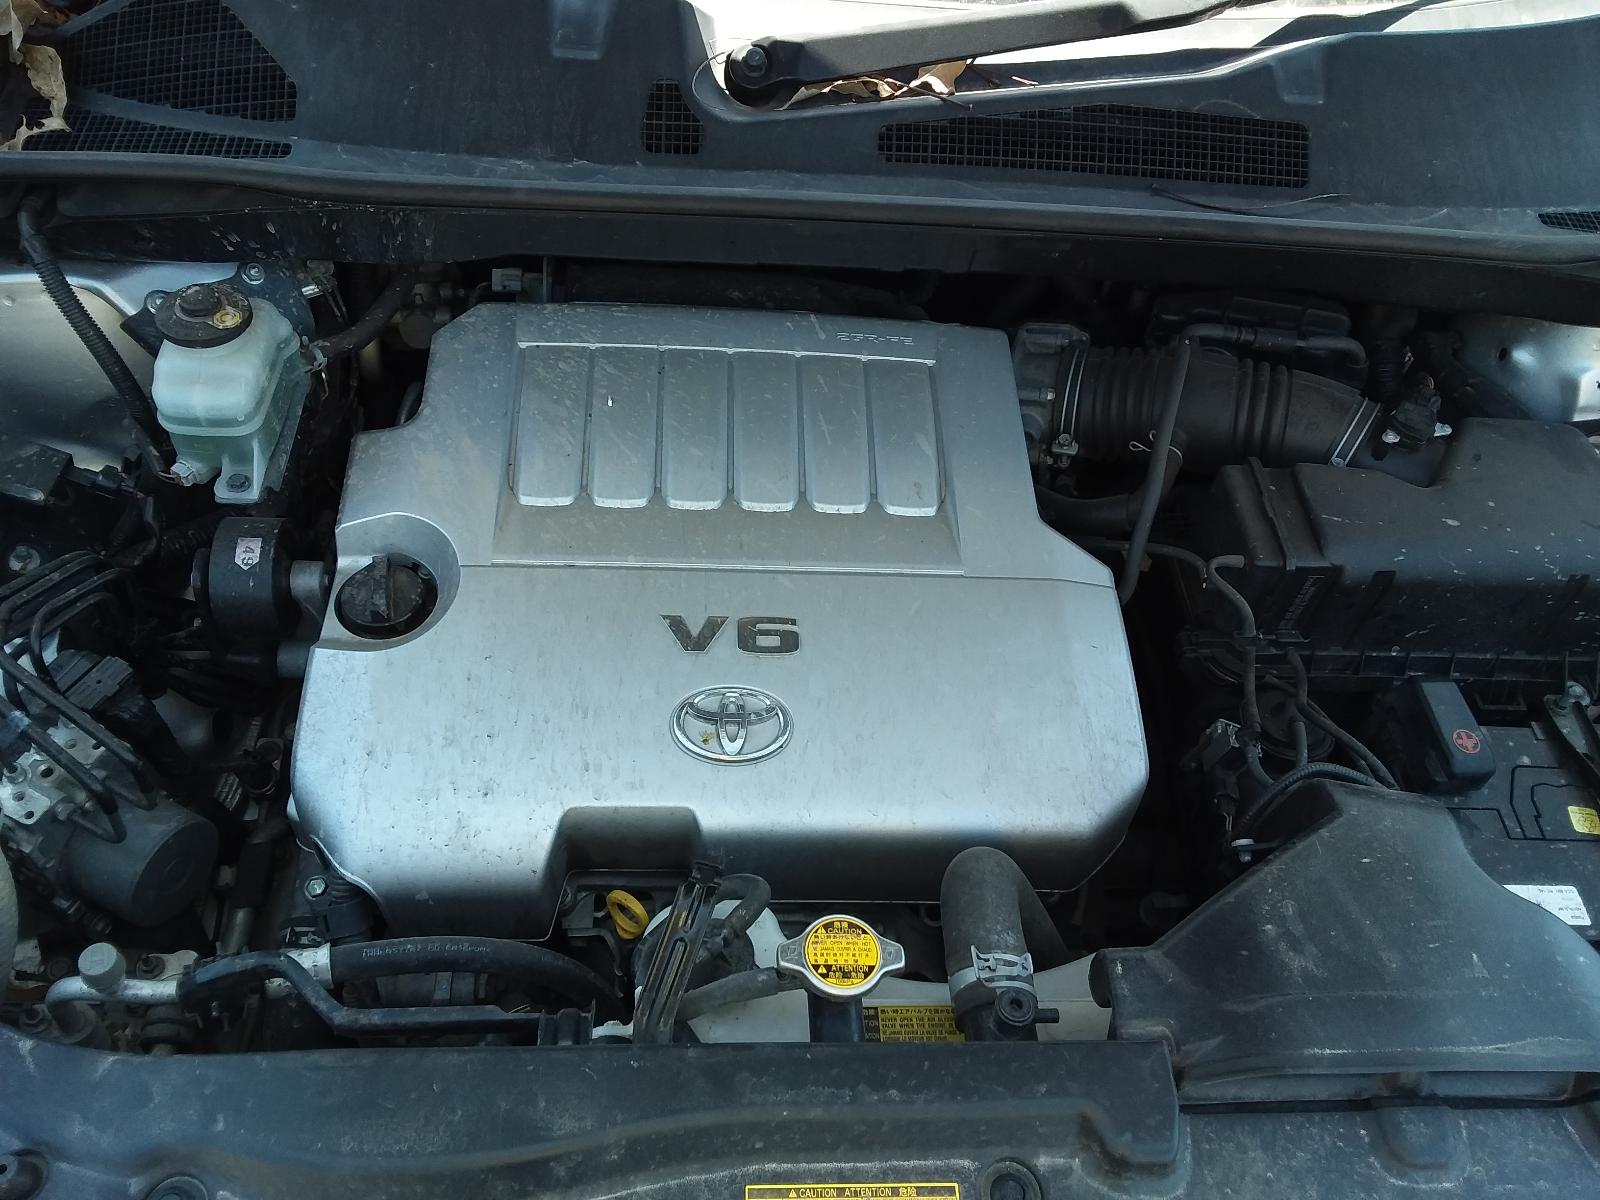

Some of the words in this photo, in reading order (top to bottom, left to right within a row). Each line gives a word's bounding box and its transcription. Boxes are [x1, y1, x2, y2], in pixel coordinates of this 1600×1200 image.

[659, 614, 800, 656] V6
[831, 964, 869, 972] ATTENTION
[799, 1188, 837, 1198] CAUTION
[844, 1187, 892, 1198] ATTENTION
